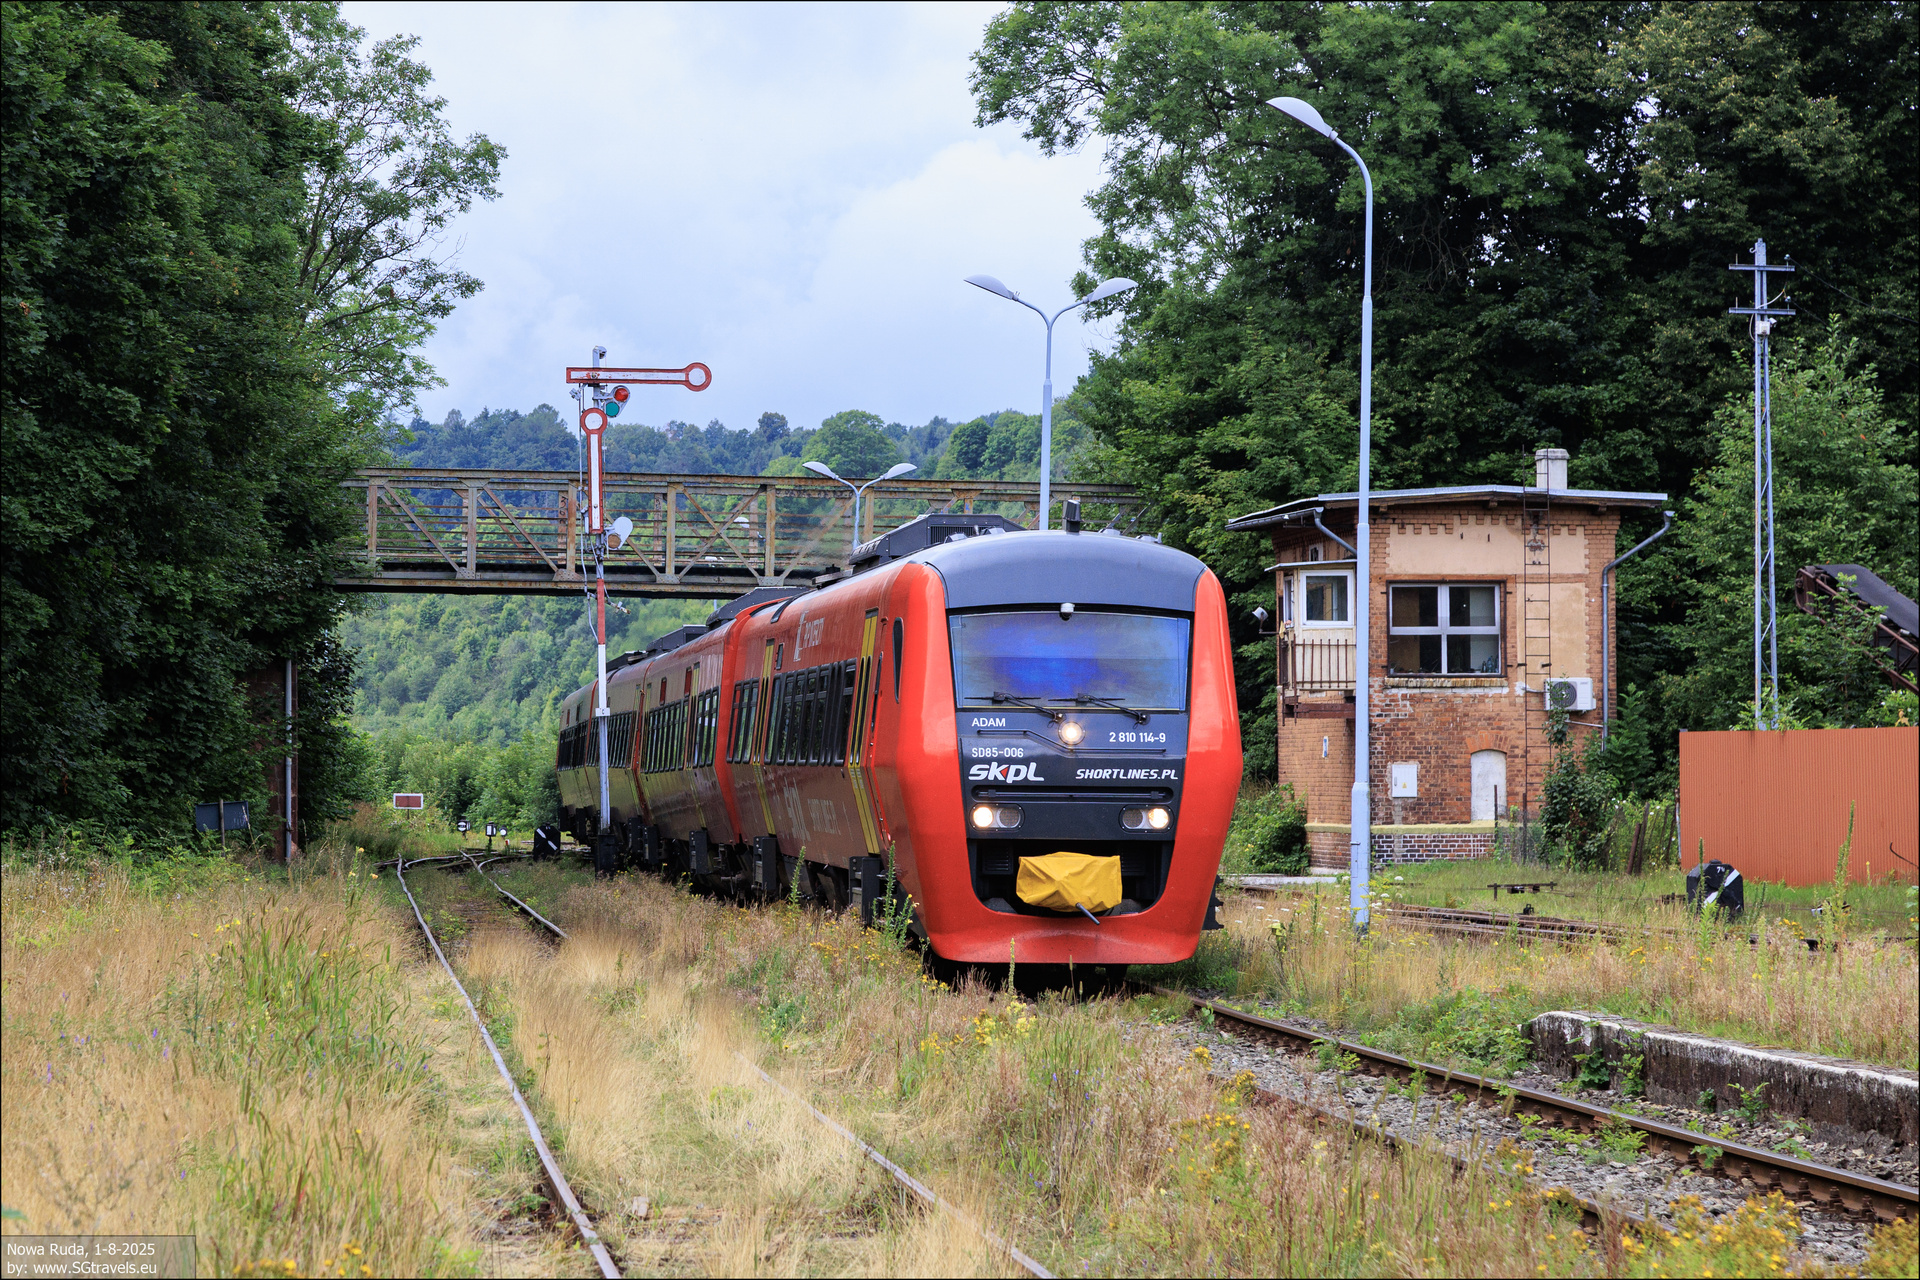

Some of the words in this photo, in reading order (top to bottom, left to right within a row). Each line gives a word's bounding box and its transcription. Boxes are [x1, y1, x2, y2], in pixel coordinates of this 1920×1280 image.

[971, 717, 1006, 727] ADAM
[1109, 732, 1115, 743] 2
[1118, 732, 1136, 743] 810
[1139, 732, 1166, 743] 114-9
[971, 747, 1024, 758] SD85-006
[1075, 769, 1179, 780] SHORTLINES.PL
